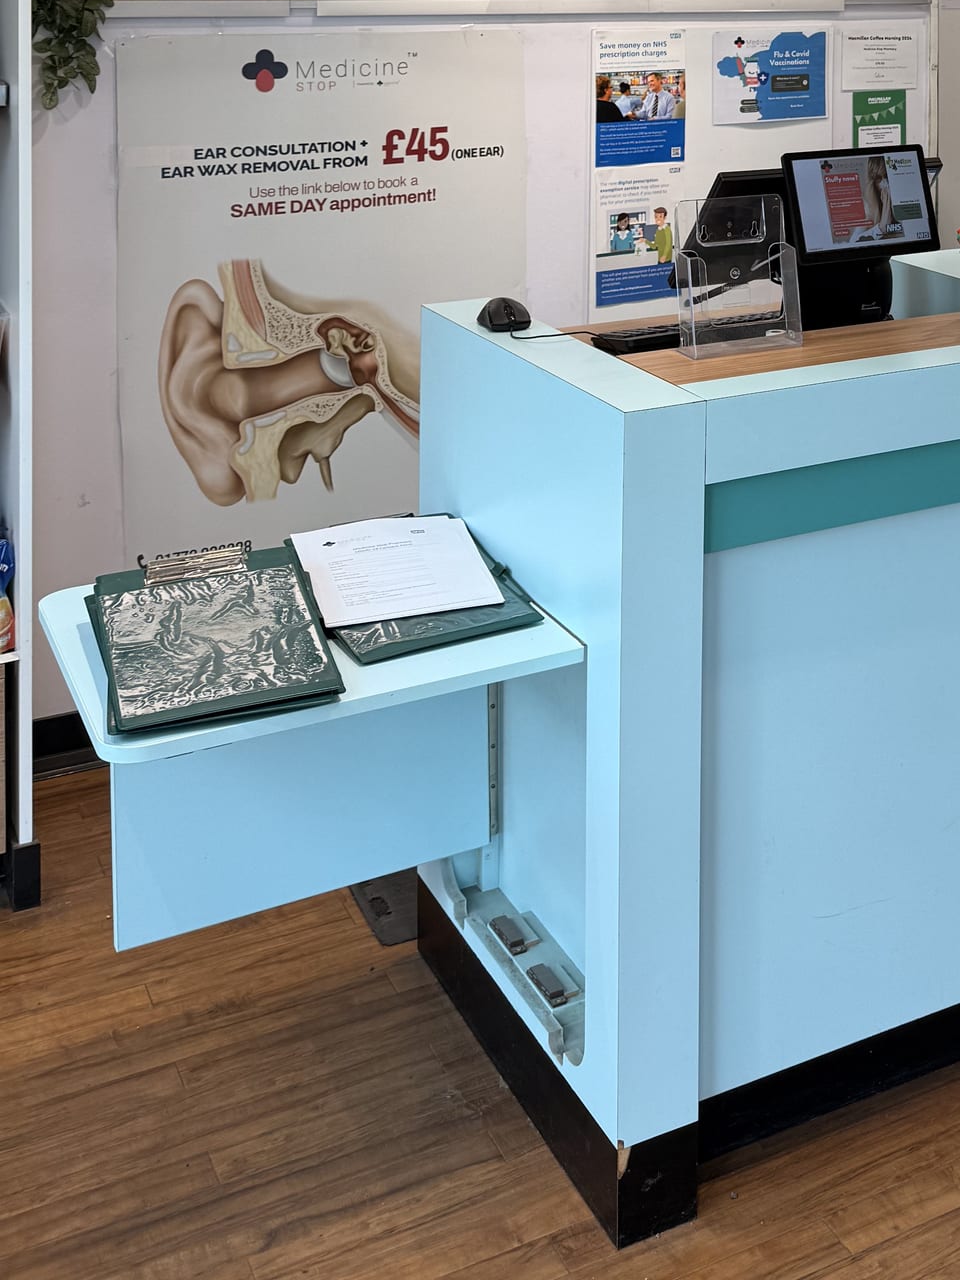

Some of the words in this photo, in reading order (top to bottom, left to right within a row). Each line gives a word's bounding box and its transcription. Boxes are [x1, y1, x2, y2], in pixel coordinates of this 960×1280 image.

[600, 50, 640, 59] prescription
[641, 49, 667, 57] charges
[770, 58, 809, 66] Vaccinations
[296, 58, 409, 79] Medicine
[295, 80, 337, 92] STOP
[161, 166, 194, 179] EAR
[197, 163, 237, 177] WAX
[241, 158, 320, 174] REMOVAL
[323, 155, 368, 170] FROM
[382, 126, 450, 165] £45
[194, 147, 227, 160] EAR
[230, 140, 356, 158] CONSULTATION
[249, 187, 276, 198] Use
[279, 185, 299, 197] the
[302, 182, 322, 195] link
[324, 179, 361, 193] below
[363, 178, 375, 190] to
[377, 176, 407, 188] book
[410, 177, 419, 186] a
[230, 201, 286, 218] SAME
[290, 198, 327, 214] DAY
[330, 188, 437, 214] appointment!
